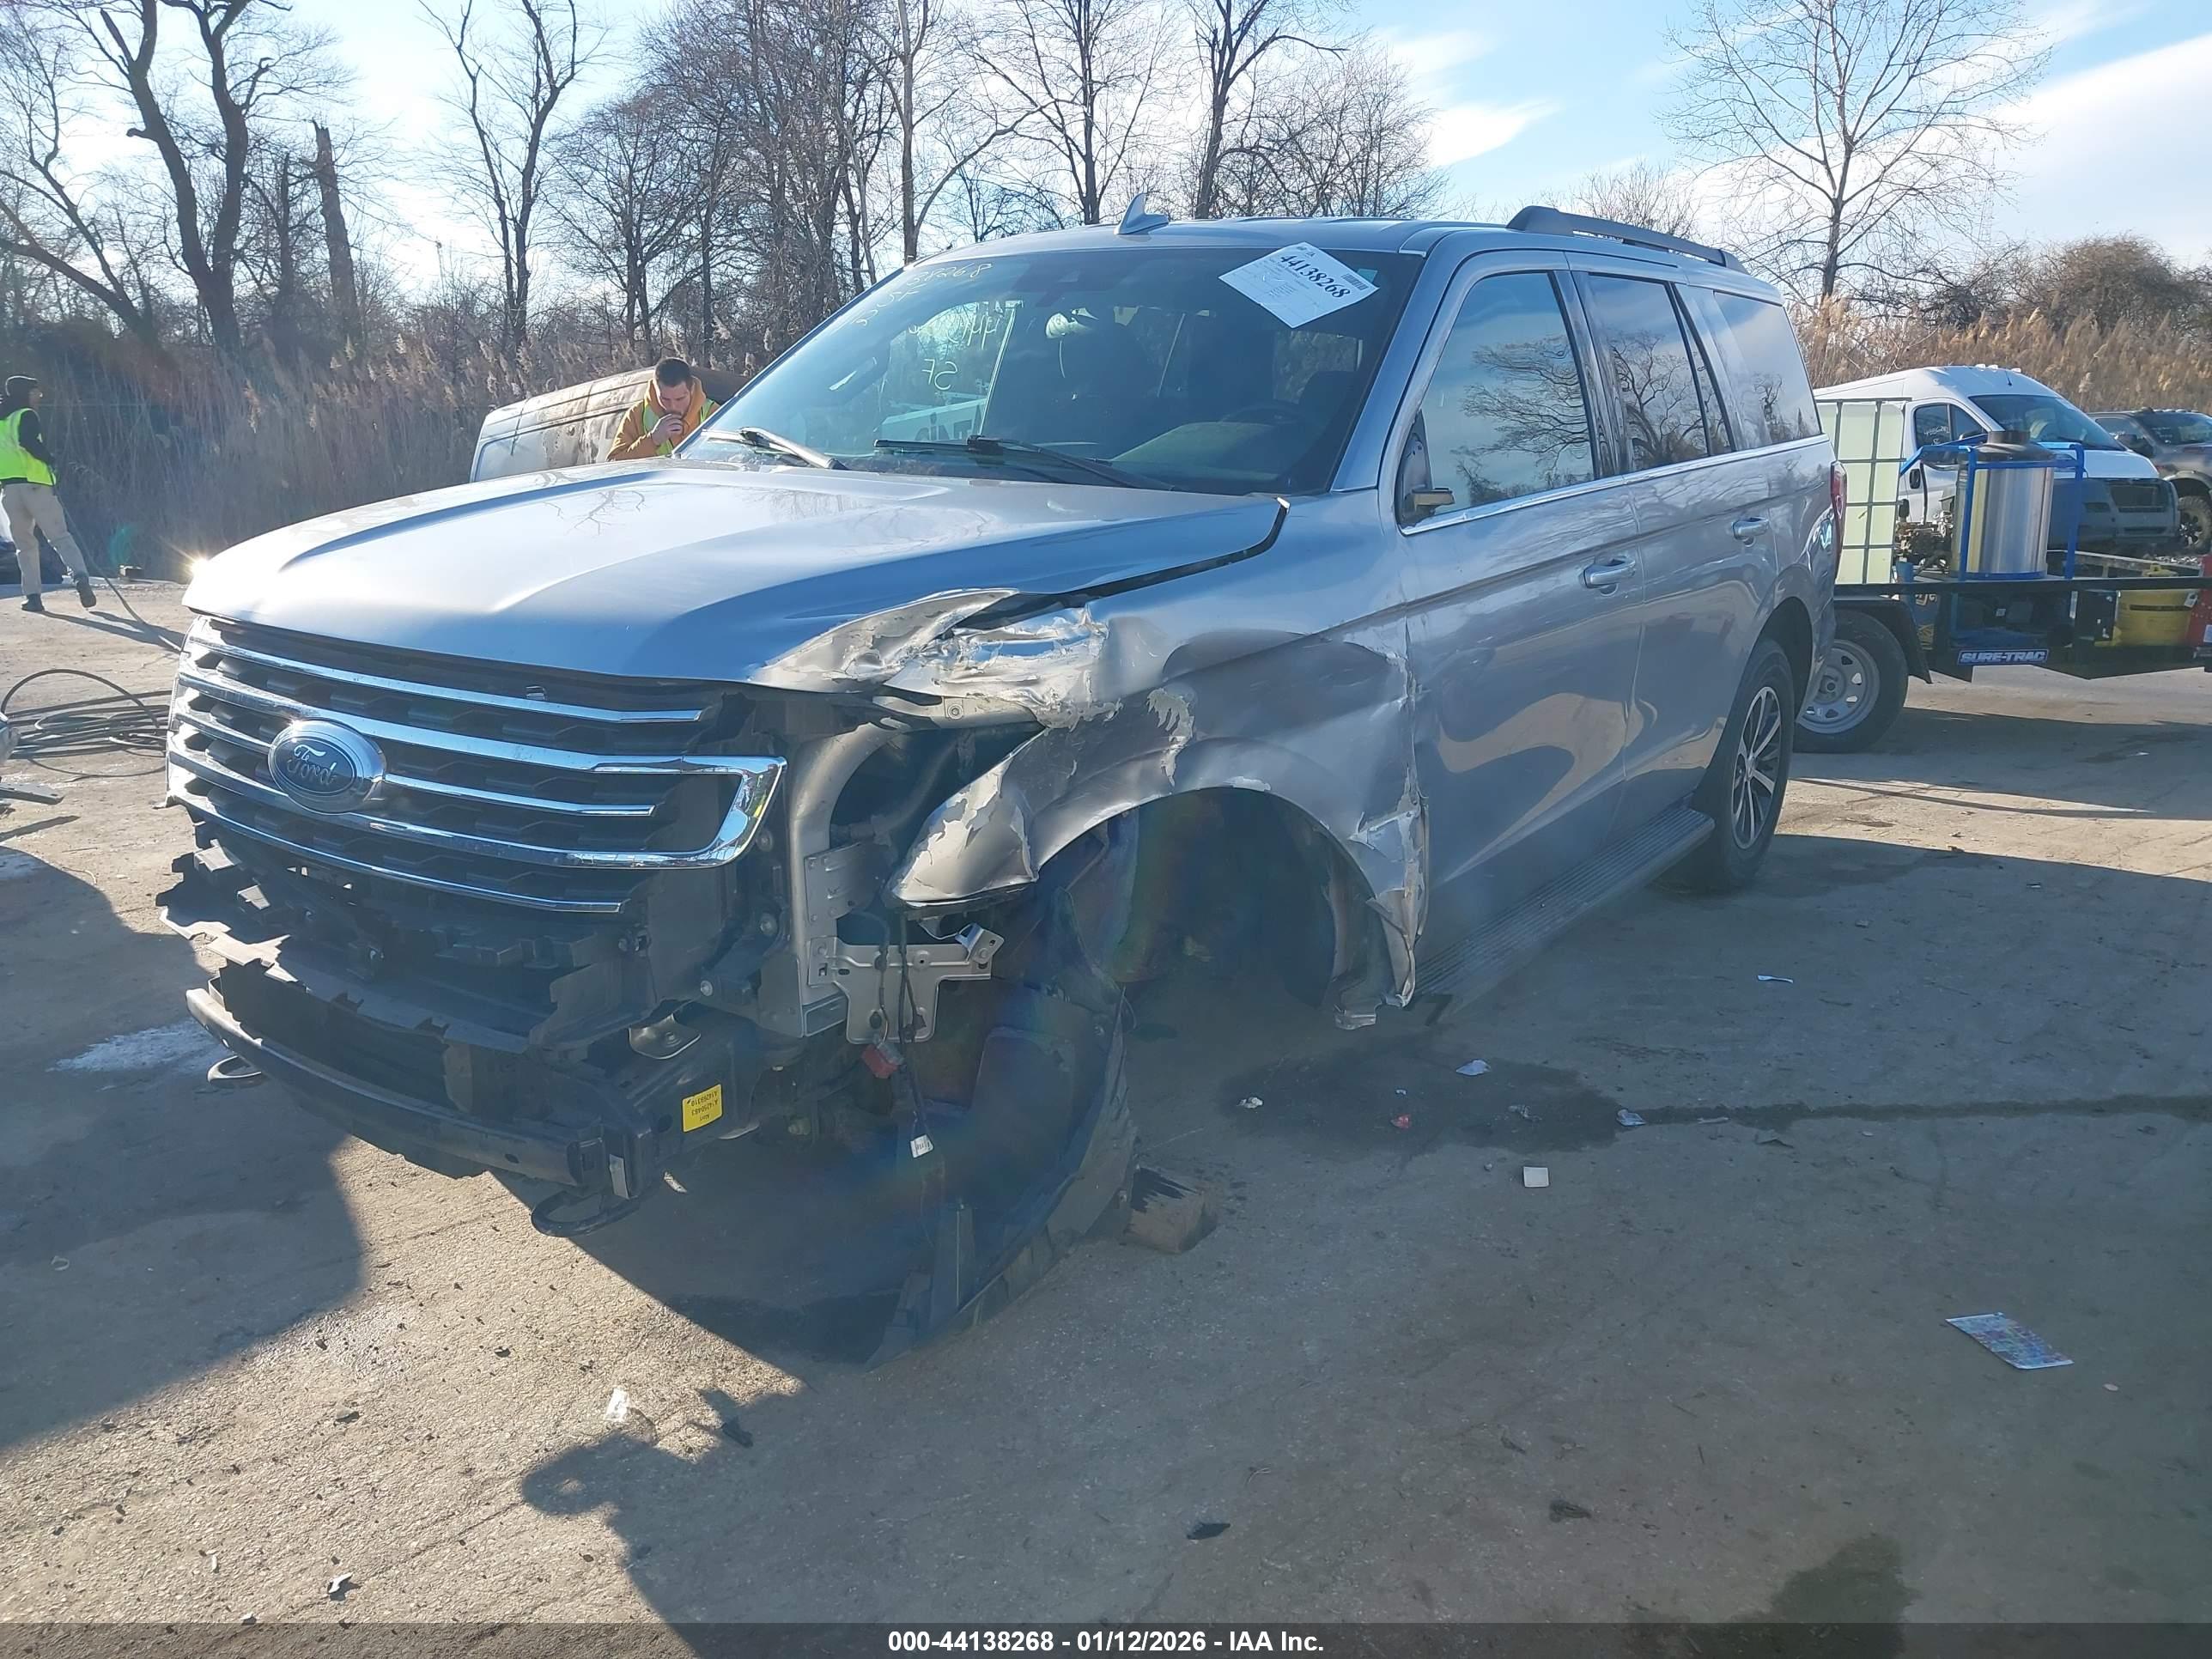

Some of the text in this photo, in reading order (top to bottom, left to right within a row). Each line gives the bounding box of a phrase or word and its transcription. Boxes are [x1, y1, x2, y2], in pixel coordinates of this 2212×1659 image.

[1279, 254, 1351, 298] 44138268
[1960, 651, 2045, 663] SURE-TRAC
[286, 744, 338, 786] Ford
